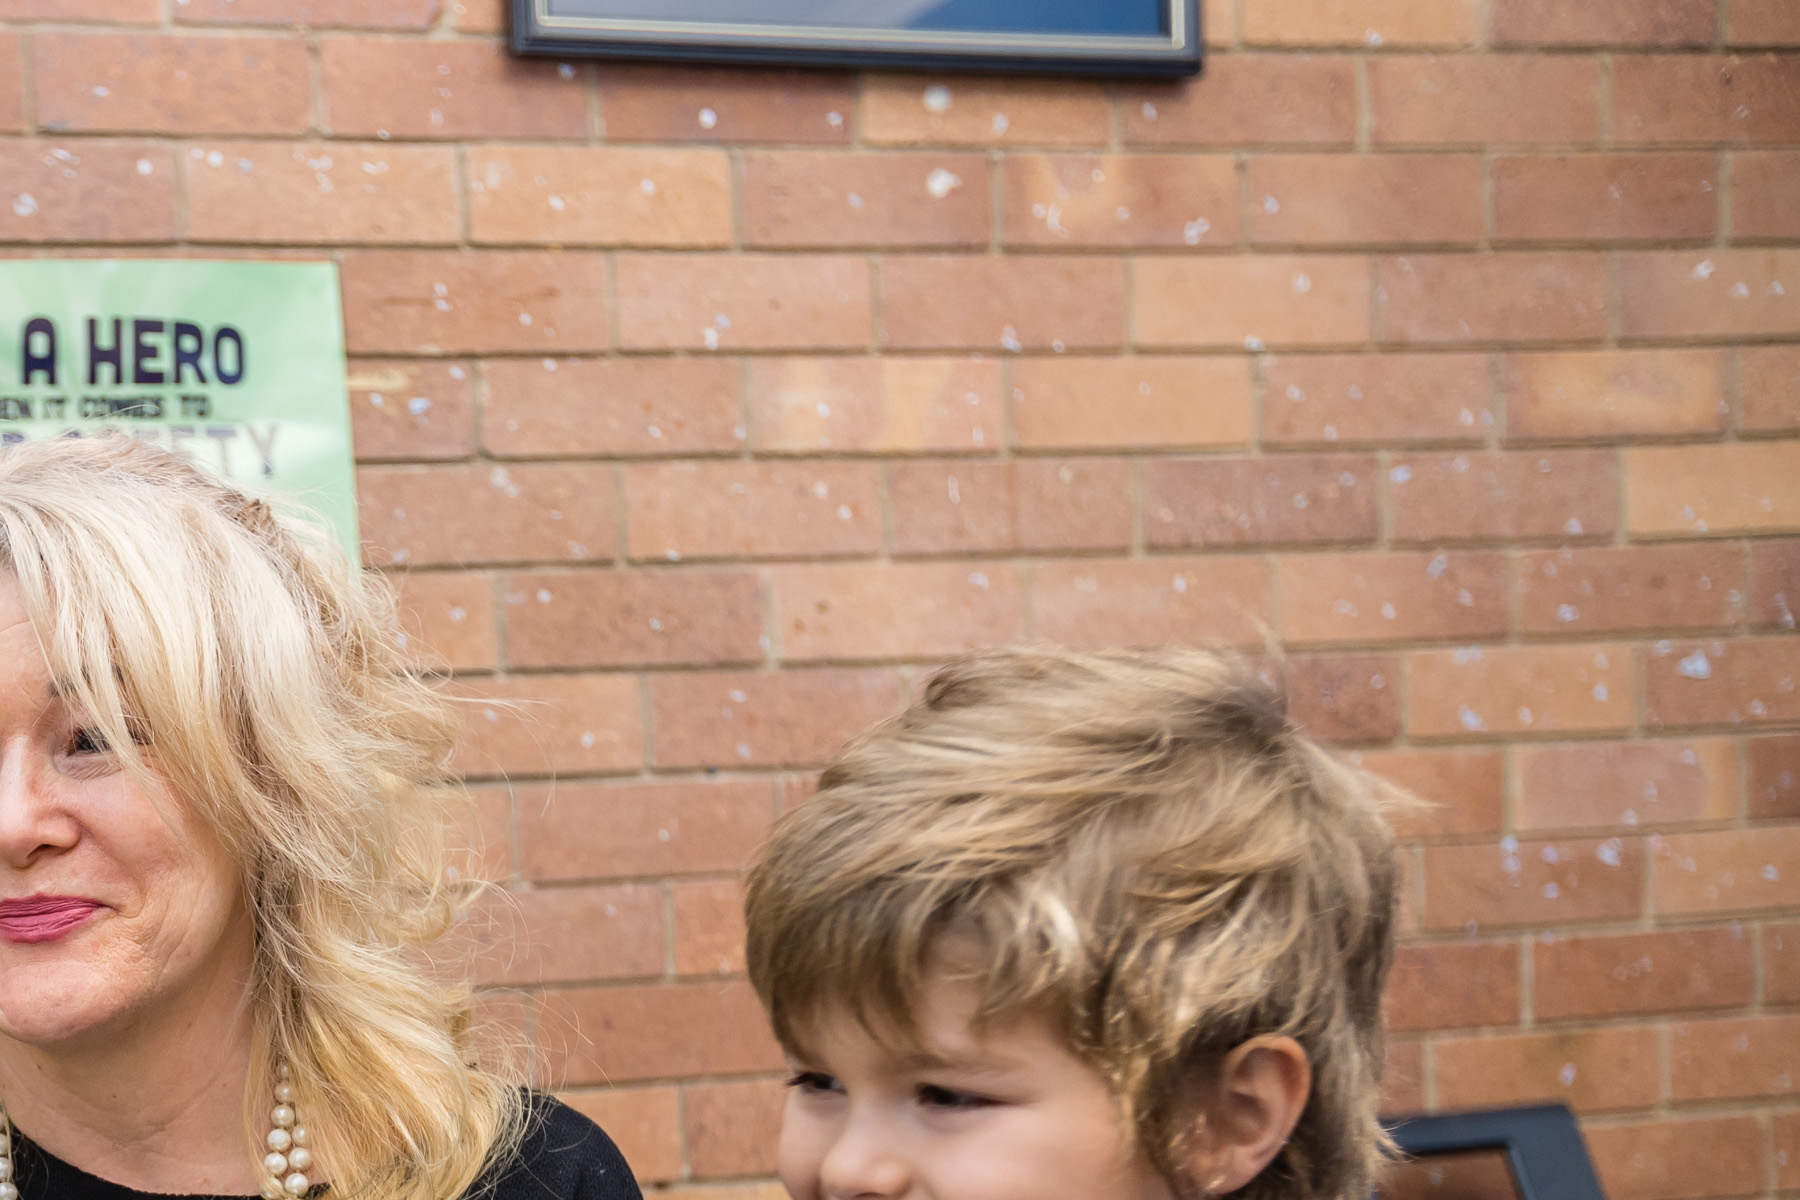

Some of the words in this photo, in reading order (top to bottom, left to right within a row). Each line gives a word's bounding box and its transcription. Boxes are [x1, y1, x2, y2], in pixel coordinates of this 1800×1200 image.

[23, 317, 57, 385] A
[88, 317, 244, 385] HERO
[43, 396, 66, 419] IT
[79, 396, 163, 418] COMES
[178, 396, 209, 418] TO
